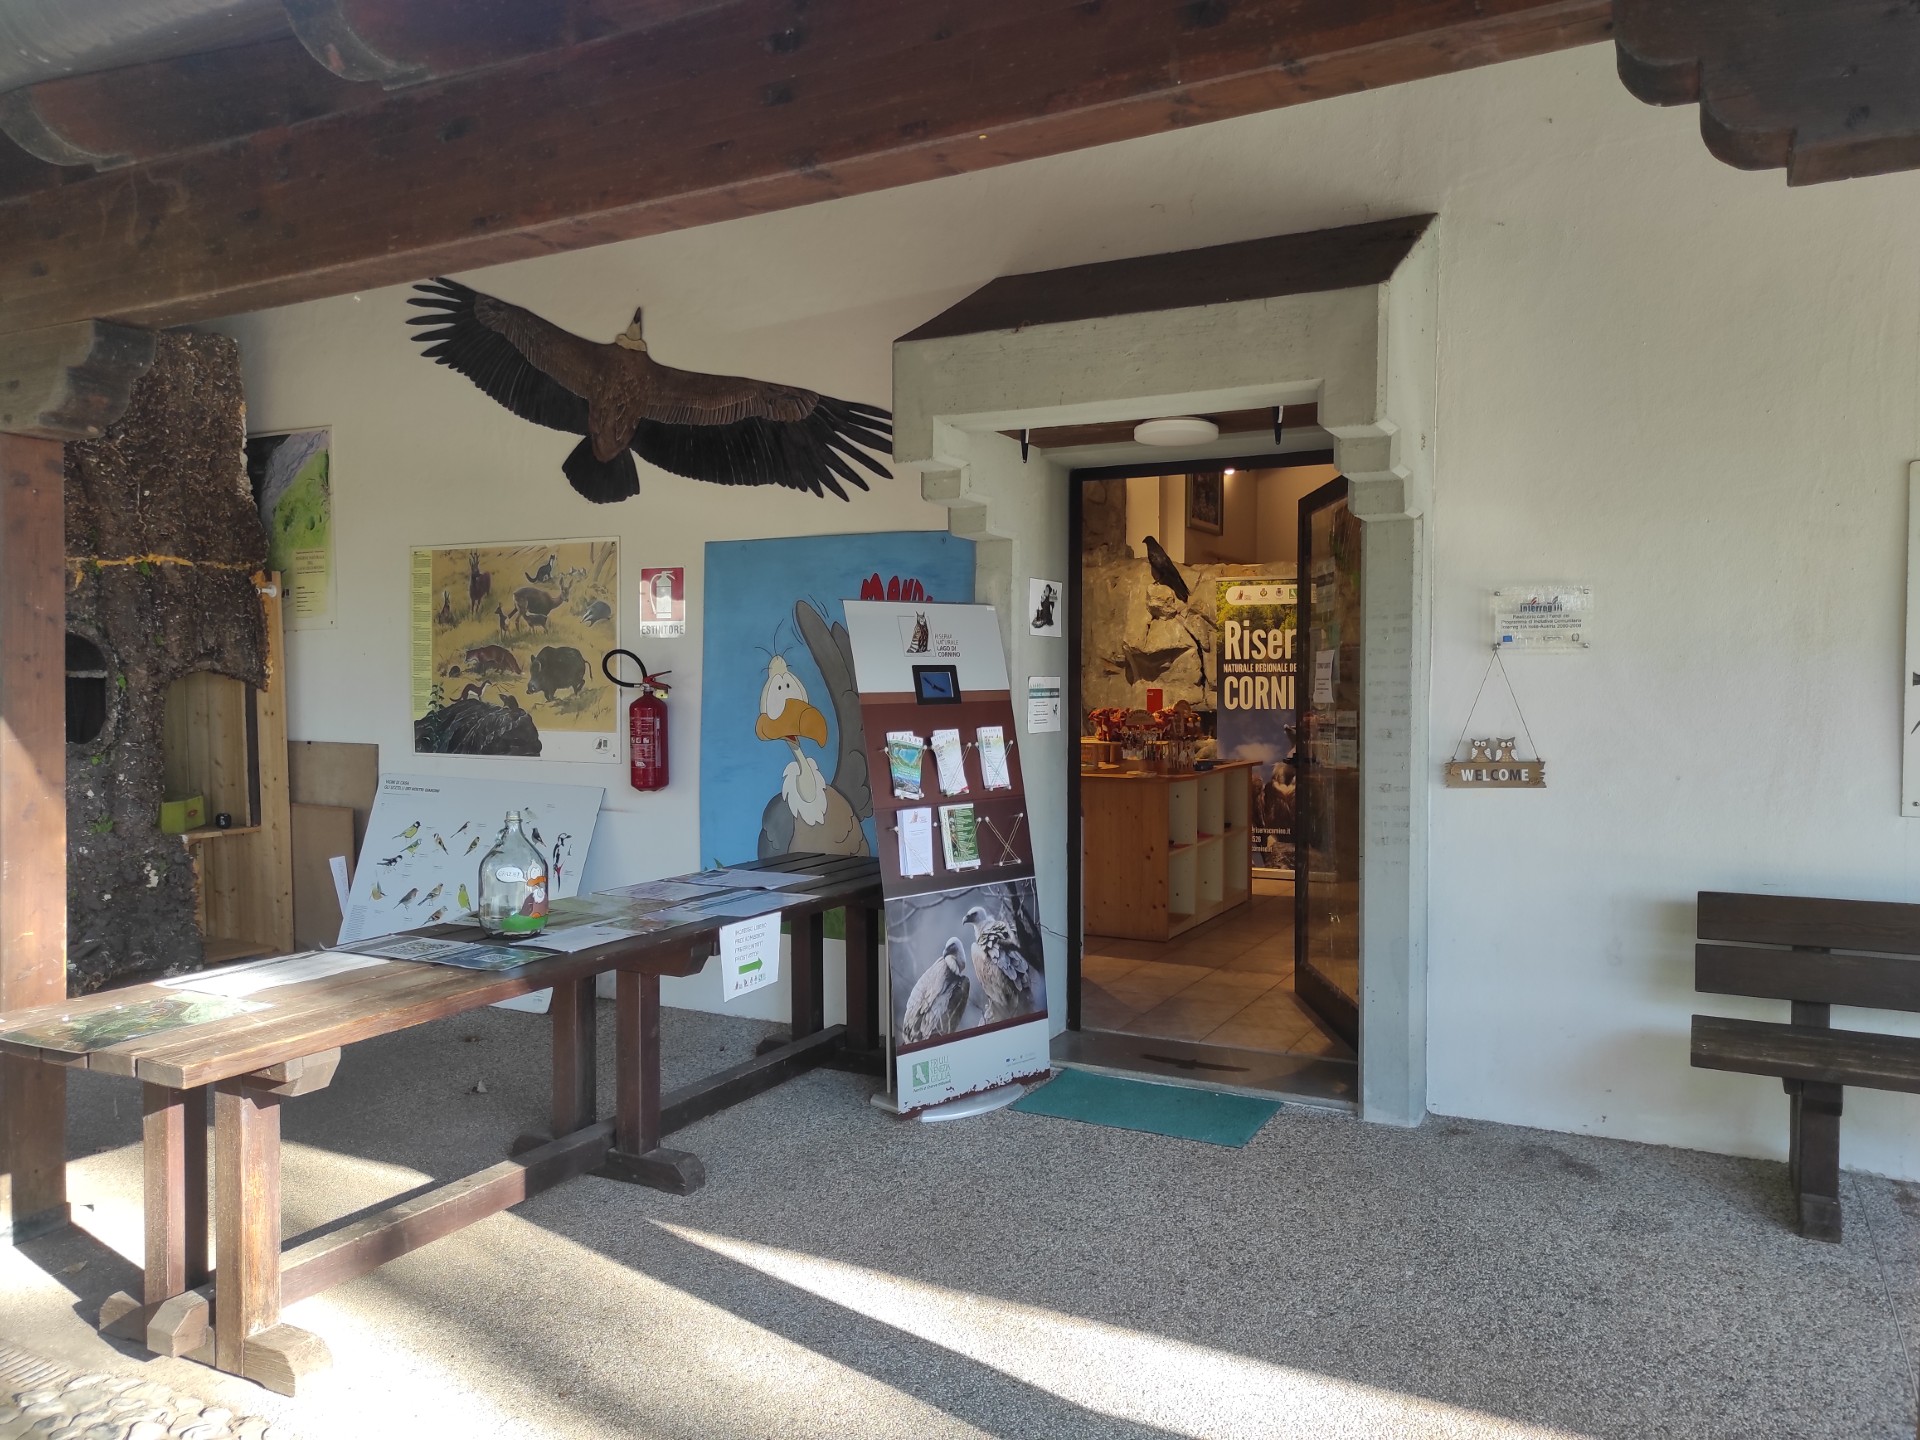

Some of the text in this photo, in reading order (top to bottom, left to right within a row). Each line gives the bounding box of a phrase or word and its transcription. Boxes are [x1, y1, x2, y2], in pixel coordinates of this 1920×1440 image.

[641, 624, 684, 635] ESTINTORE
[1224, 620, 1297, 660] Riser
[1223, 663, 1254, 673] NATURALE
[1255, 663, 1288, 673] REGIONALE
[1224, 675, 1295, 710] CORNI
[1461, 768, 1530, 782] WELCOME
[930, 1055, 949, 1067] FRIULI
